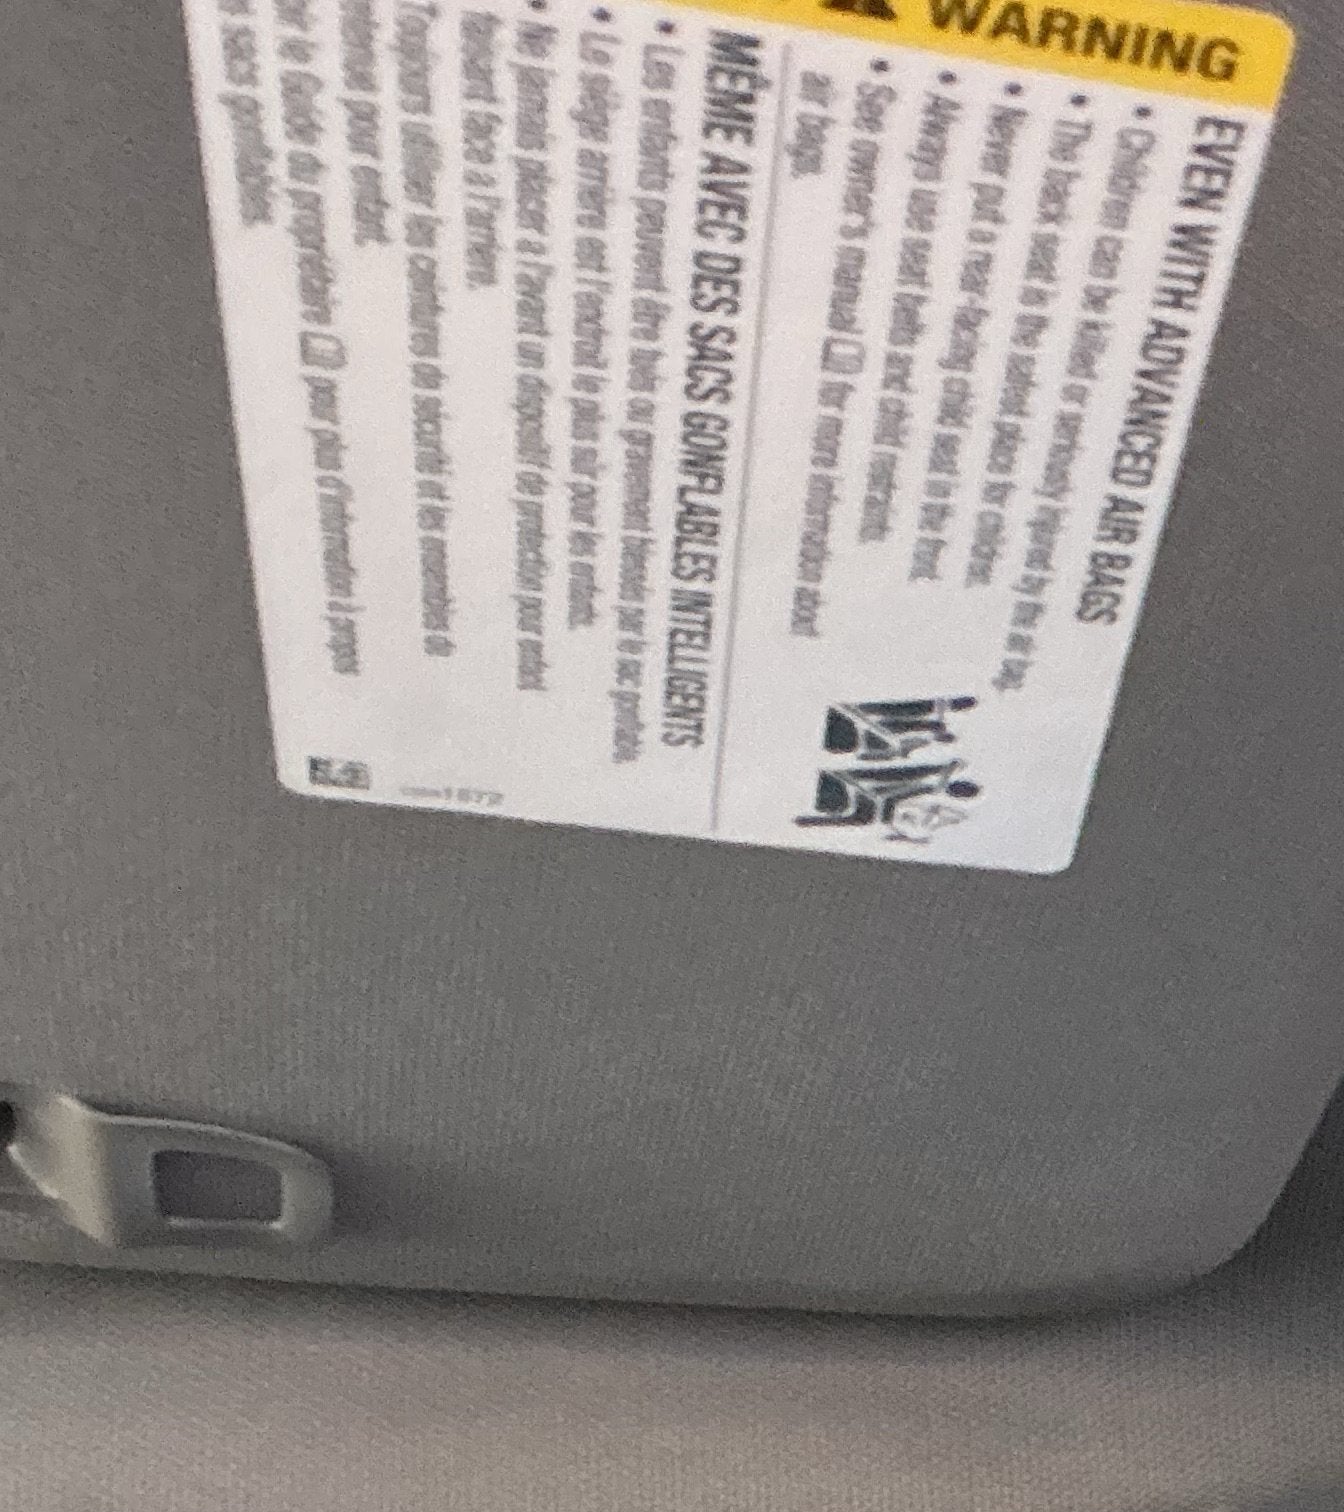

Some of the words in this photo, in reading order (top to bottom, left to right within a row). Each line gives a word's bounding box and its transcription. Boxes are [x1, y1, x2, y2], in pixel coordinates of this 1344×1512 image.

[701, 30, 772, 143] MÊME
[928, 0, 1242, 83] WARNING
[696, 151, 752, 244] AVEC
[1176, 117, 1247, 212] EVEN
[689, 251, 743, 313] DES
[1152, 224, 1217, 312] WITH
[685, 322, 736, 403] SACS
[1110, 320, 1193, 488] ADVANCED
[670, 411, 728, 583] GONFLABLES
[1095, 494, 1145, 543] AIR
[1075, 551, 1132, 625] BAGS
[660, 587, 715, 749] INTELLIGENTS
